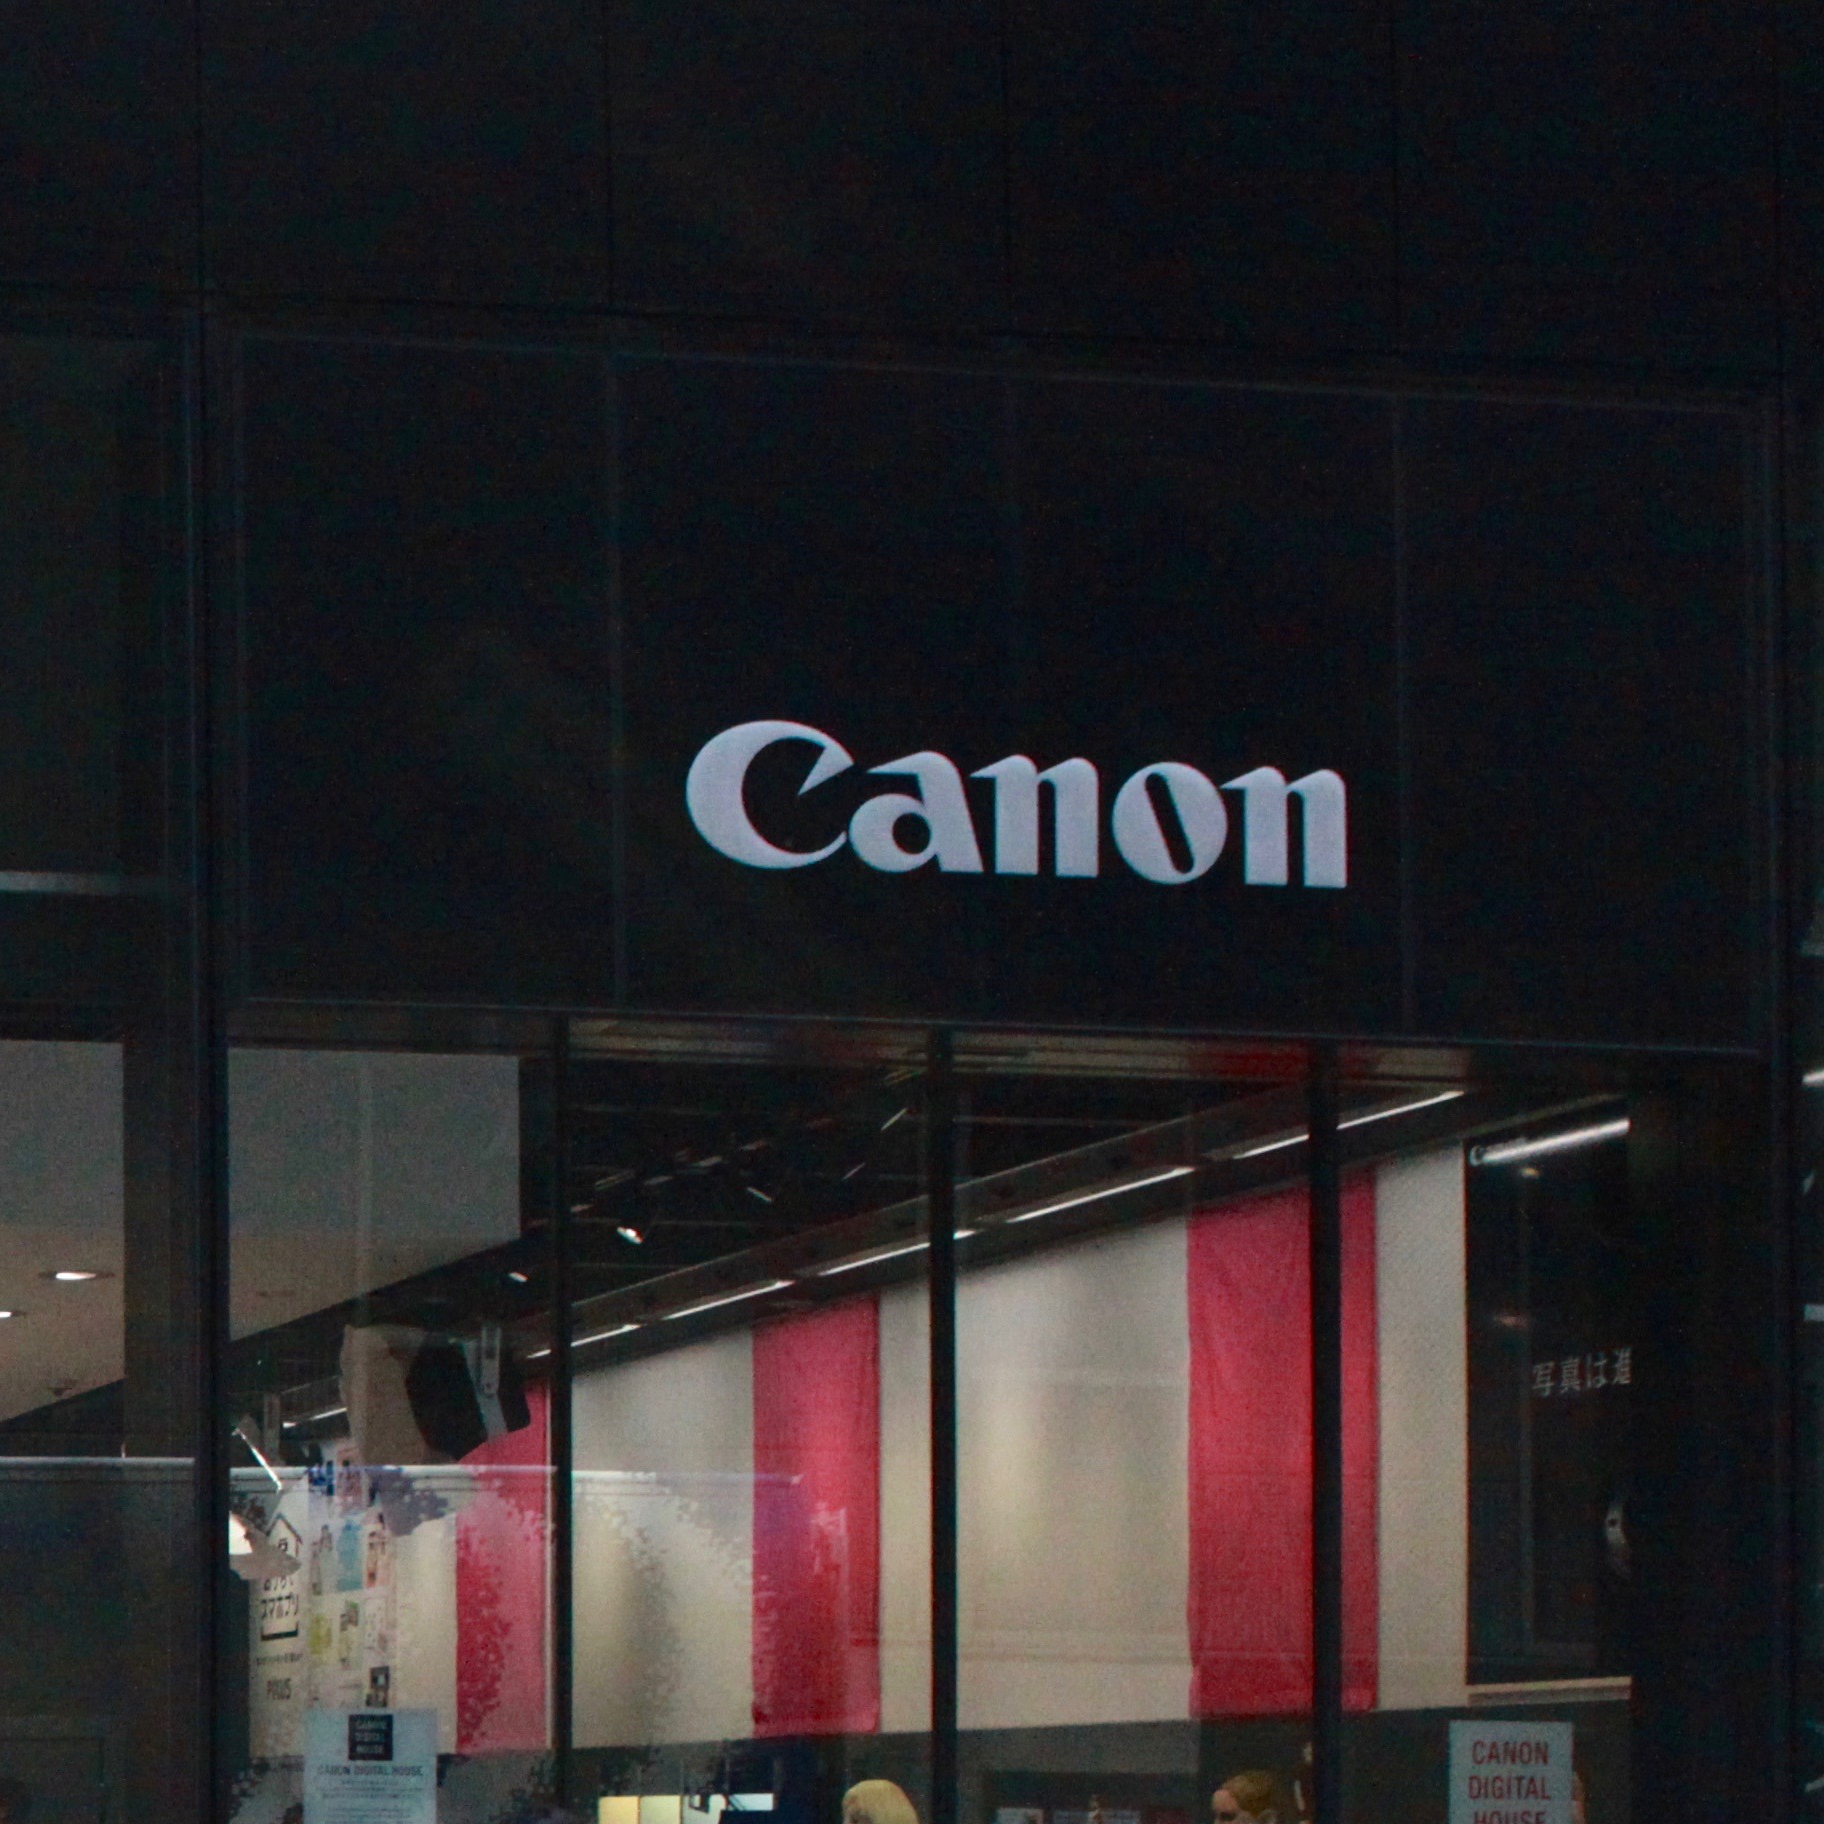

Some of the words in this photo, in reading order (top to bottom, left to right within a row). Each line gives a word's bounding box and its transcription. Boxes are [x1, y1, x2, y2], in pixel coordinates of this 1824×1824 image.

[686, 719, 1347, 888] Canon
[1472, 1740, 1549, 1765] CANON
[1468, 1775, 1552, 1800] DIGITAL
